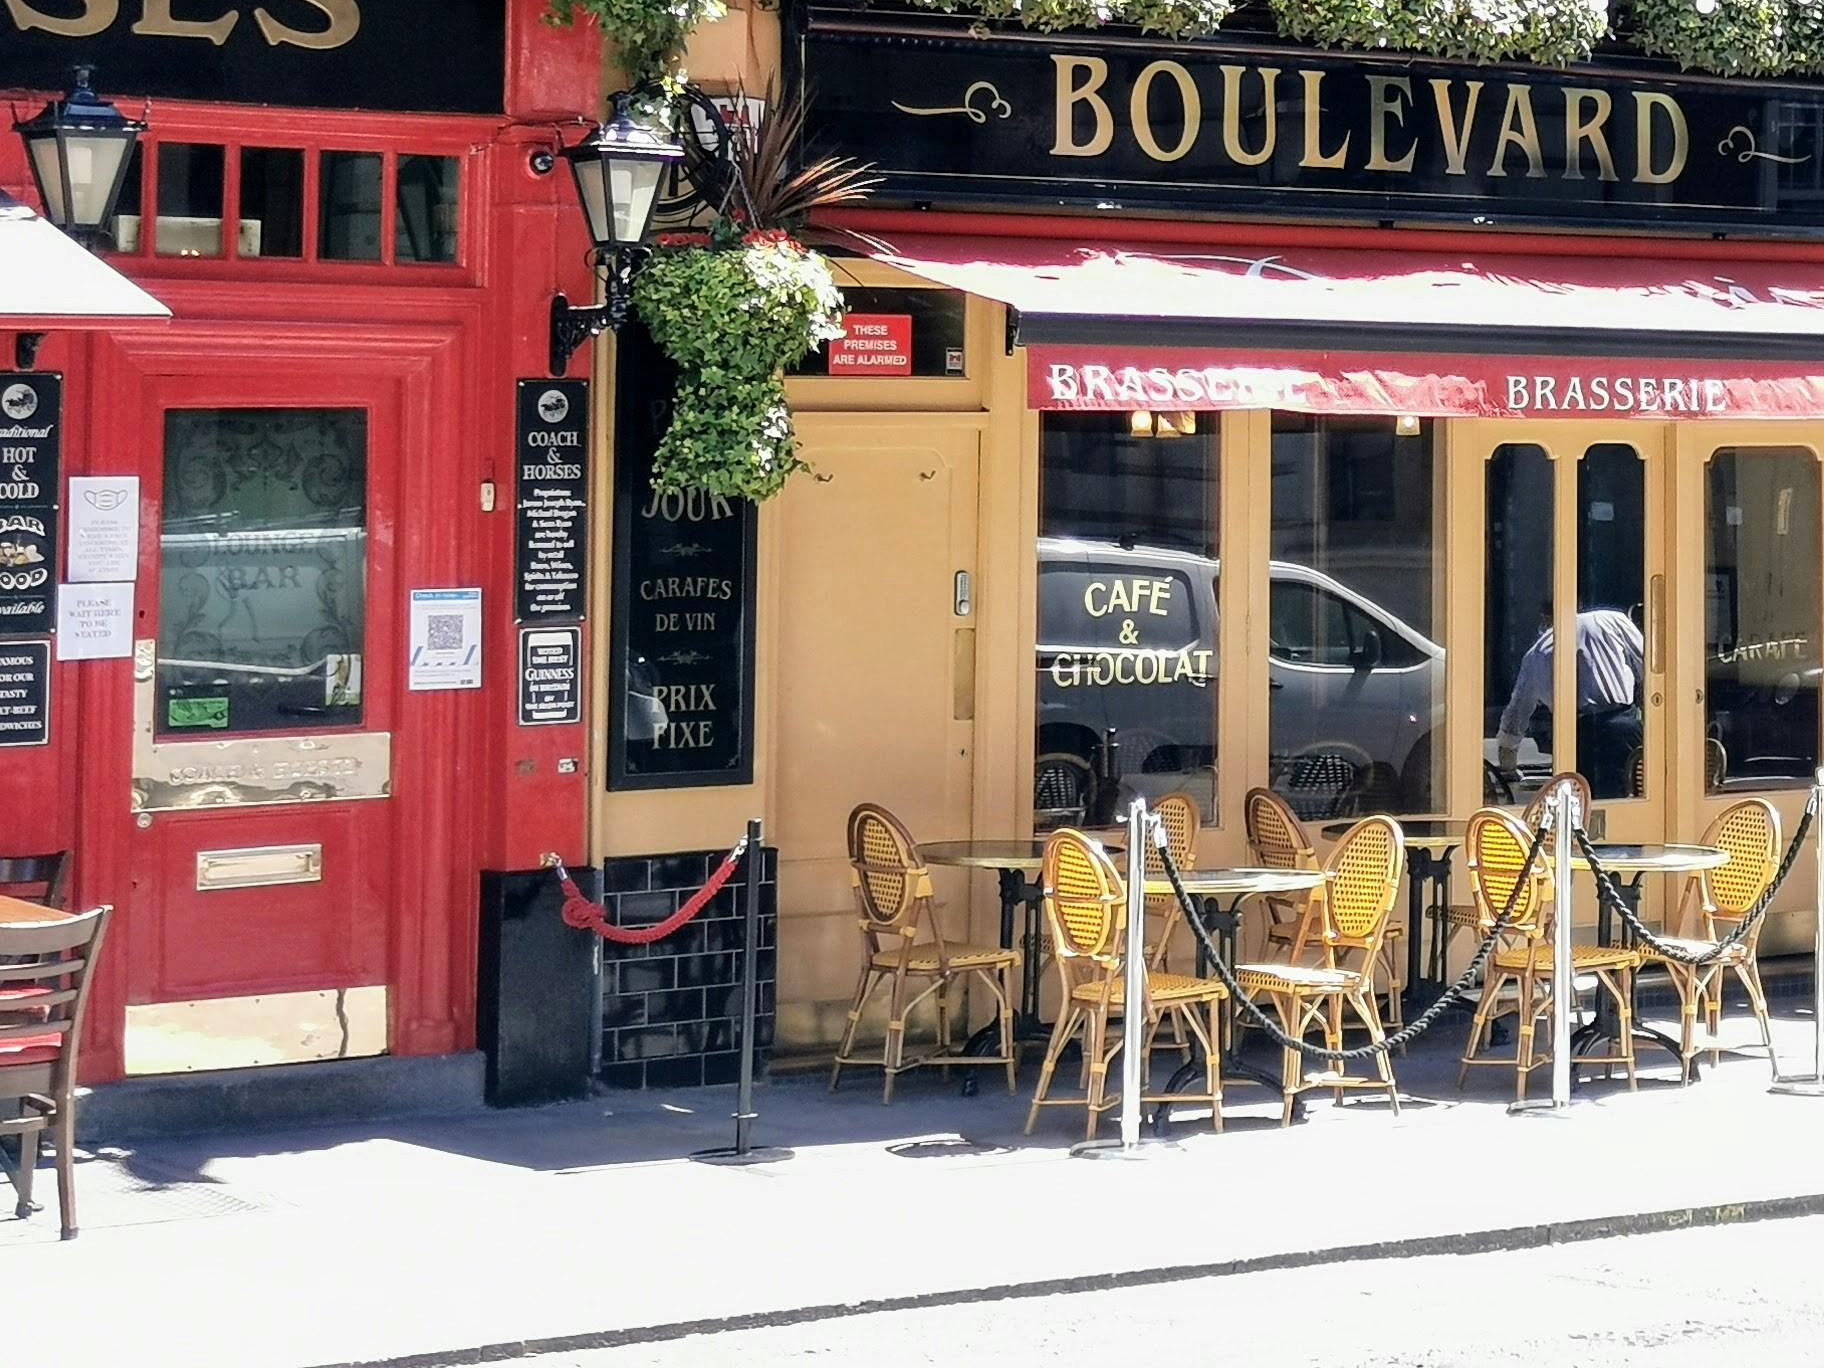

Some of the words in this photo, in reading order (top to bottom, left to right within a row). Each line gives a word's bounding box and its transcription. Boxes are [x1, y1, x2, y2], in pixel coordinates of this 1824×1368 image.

[1049, 54, 1690, 184] BOULEVARD
[853, 325, 888, 336] THESE
[844, 340, 897, 350] PREMISES
[833, 355, 854, 365] ARE
[857, 355, 907, 366] ALARMED
[1047, 364, 1305, 402] BRASSEE
[1507, 376, 1727, 411] BRASSERIE
[528, 431, 580, 446] COACH
[2, 447, 37, 463] HOT
[547, 447, 563, 463] &
[12, 464, 30, 481] &
[523, 464, 581, 480] HORSES
[0, 482, 40, 499] COLD
[641, 487, 734, 522] JOUR
[640, 577, 733, 601] CARAFES
[1084, 576, 1174, 617] CAFÉ
[77, 599, 112, 607] PLEASE
[655, 613, 678, 632] DE
[686, 612, 715, 631] VIN
[1119, 618, 1139, 644] &
[525, 668, 575, 681] GUINNESS
[1052, 650, 1213, 687] CHOCOLAT
[653, 684, 716, 712] PRIX
[652, 721, 714, 749] FIXE
